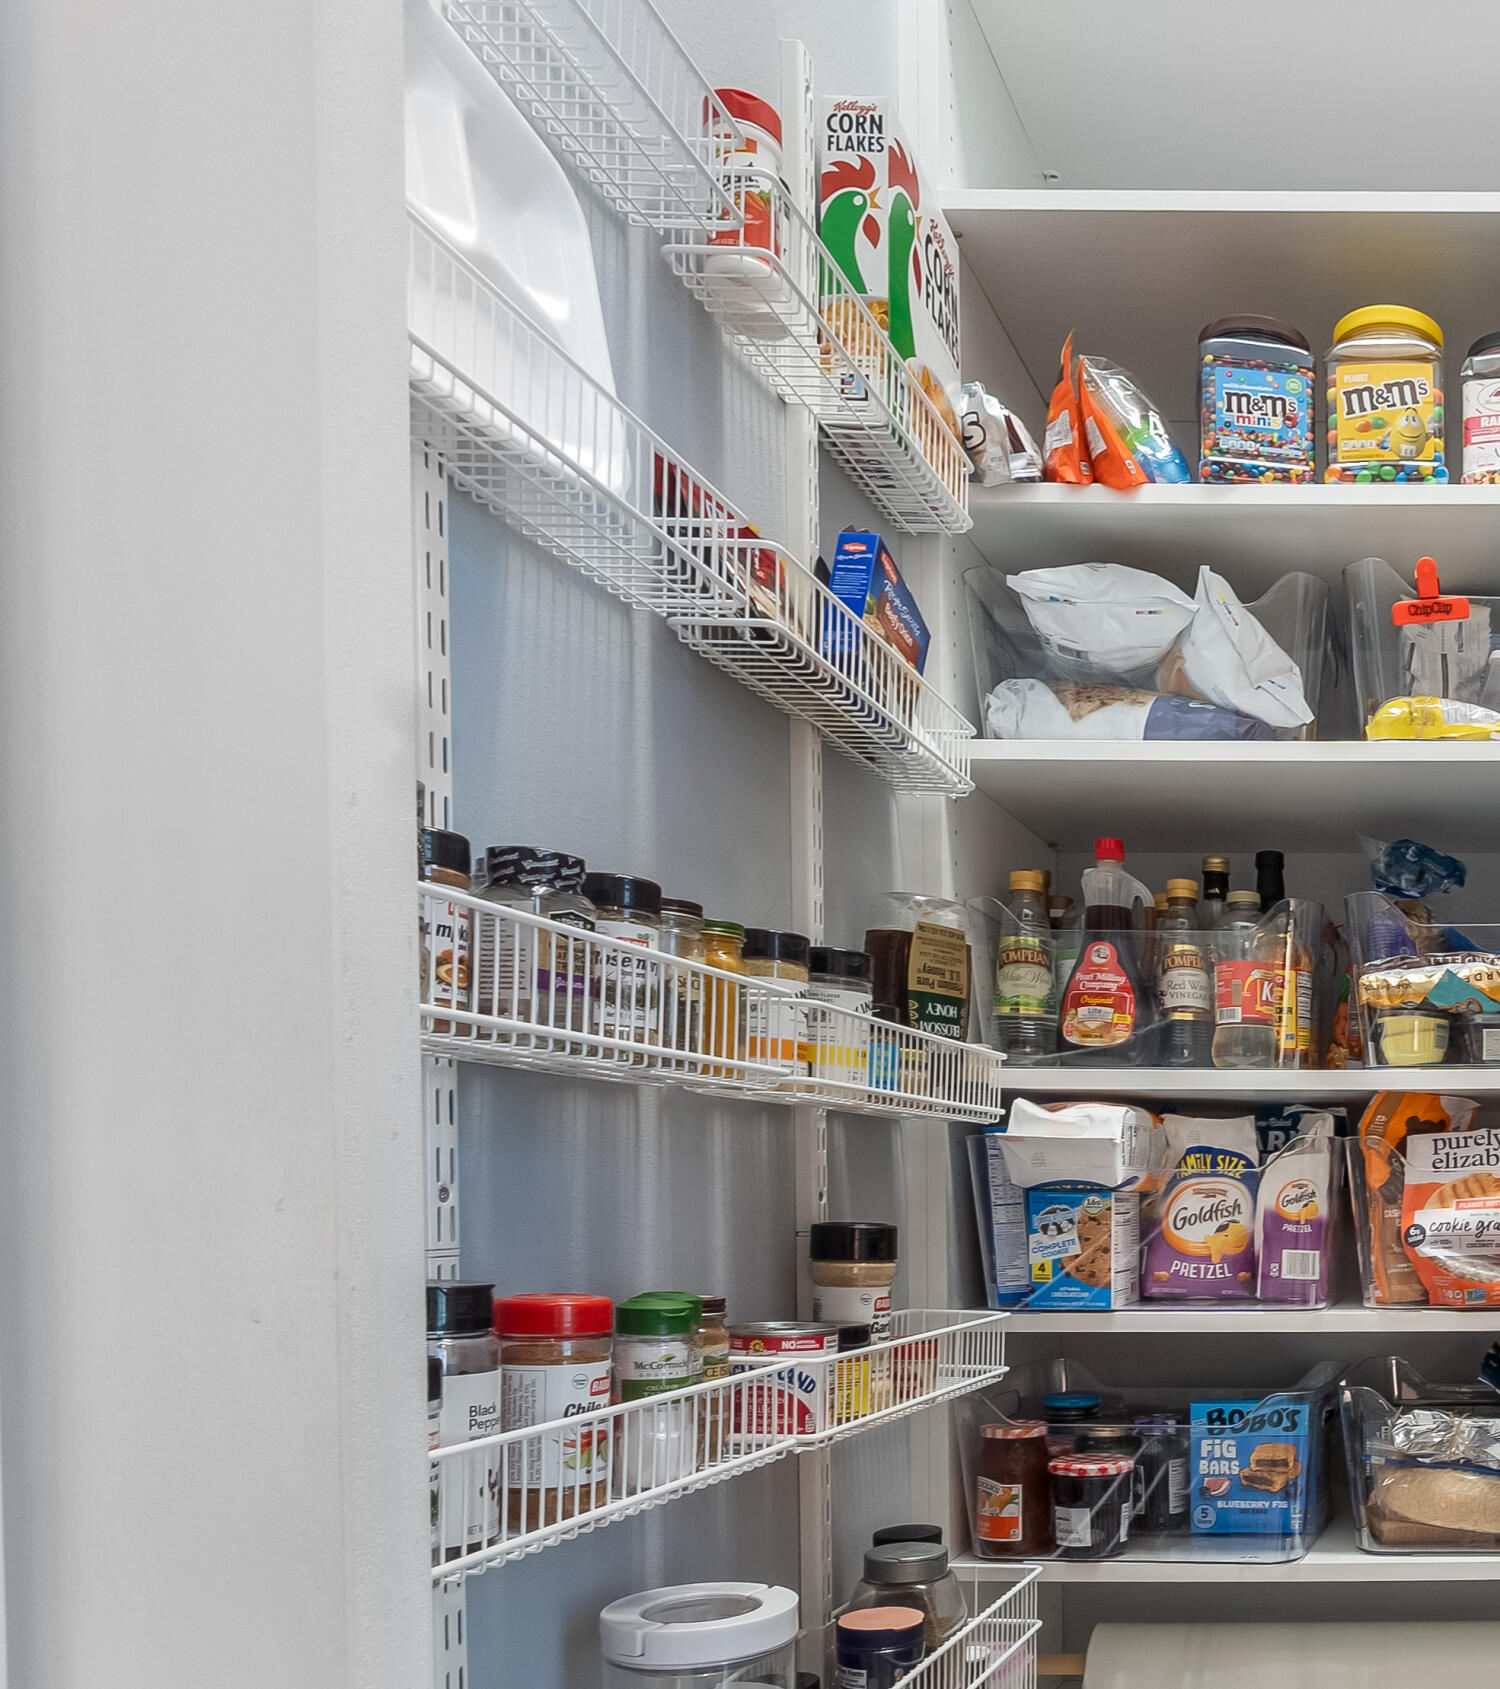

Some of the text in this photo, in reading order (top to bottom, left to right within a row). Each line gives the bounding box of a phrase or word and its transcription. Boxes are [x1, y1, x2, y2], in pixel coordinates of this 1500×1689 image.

[826, 113, 883, 134] CORN
[827, 135, 886, 152] FLAKES
[1235, 414, 1281, 428] minis
[1408, 601, 1452, 617] ChipClip
[925, 1002, 958, 1018] HONEY
[919, 1020, 961, 1038] BLOSSOM
[1215, 1155, 1248, 1179] SIZE
[1281, 1189, 1317, 1208] Goldfish
[1173, 1198, 1243, 1231] Goldfish
[1280, 1223, 1313, 1233] PRETZEL
[1429, 1217, 1472, 1233] cookie
[1031, 1238, 1077, 1254] COMPLETE
[1037, 1262, 1047, 1273] 4
[1170, 1260, 1233, 1279] PRETZEL
[781, 1341, 797, 1350] NO
[633, 1361, 688, 1371] McCormick
[469, 1402, 497, 1418] Black
[1207, 1407, 1301, 1436] BOBO'S
[1199, 1460, 1240, 1475] BARS
[1216, 1500, 1289, 1508] BLUEBERRY FIG
[1201, 1507, 1209, 1519] 5
